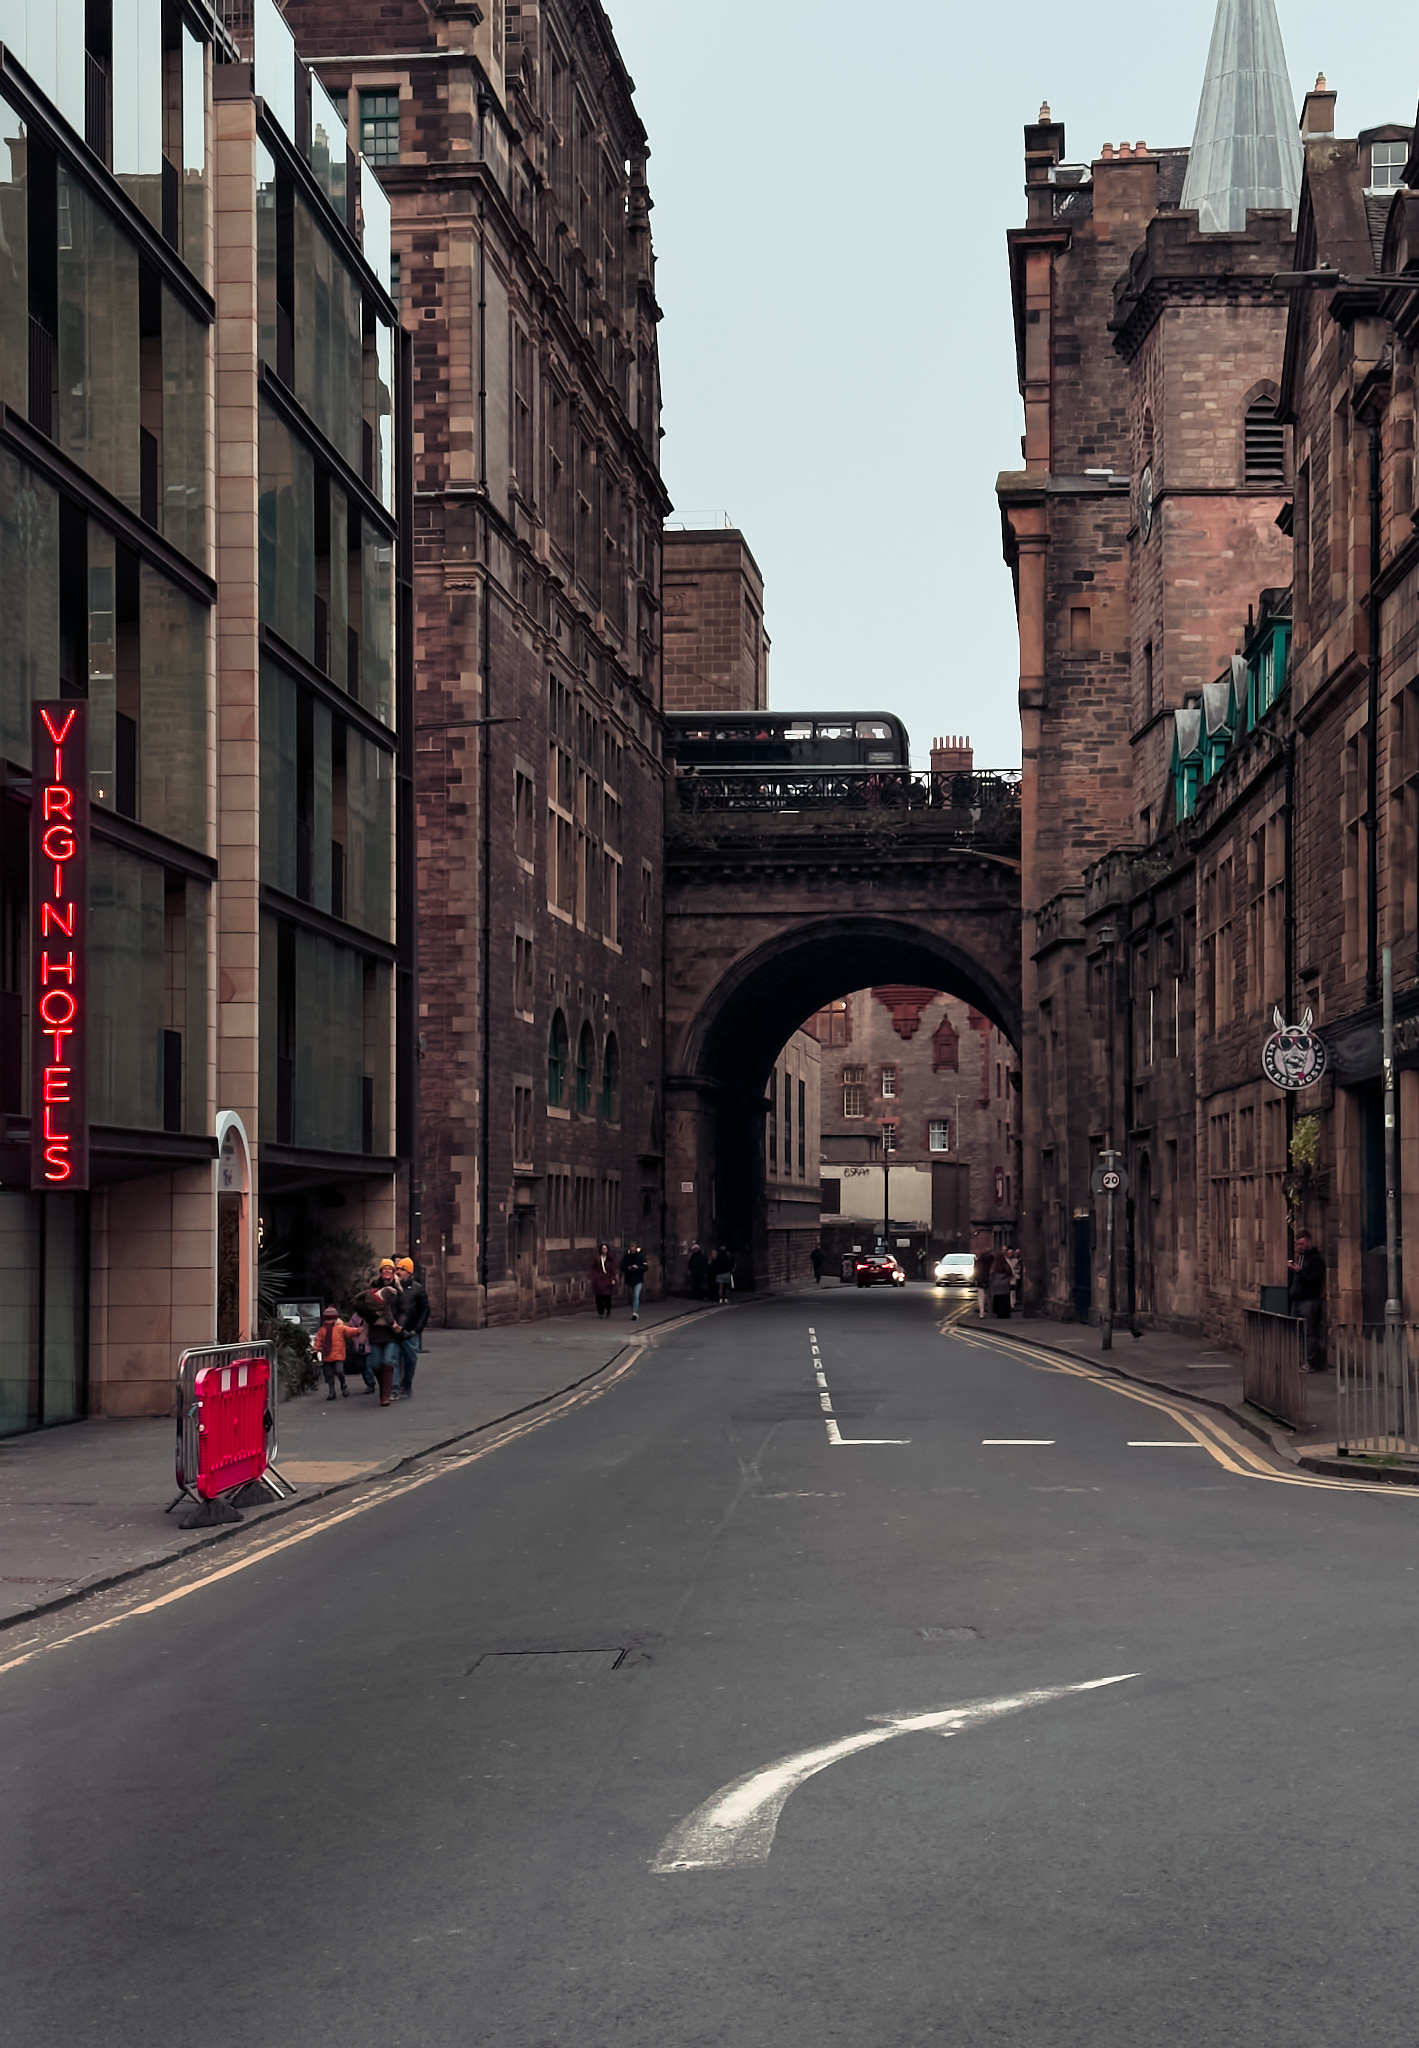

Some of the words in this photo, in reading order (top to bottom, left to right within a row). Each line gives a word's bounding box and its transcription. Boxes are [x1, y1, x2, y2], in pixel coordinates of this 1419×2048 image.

[40, 708, 76, 938] VIRGIN
[40, 950, 76, 1182] HOTELS
[1266, 1043, 1277, 1072] KICK
[1274, 1072, 1294, 1086] ASS
[1298, 1043, 1324, 1086] HOSTELS
[1104, 1176, 1118, 1185] 20
